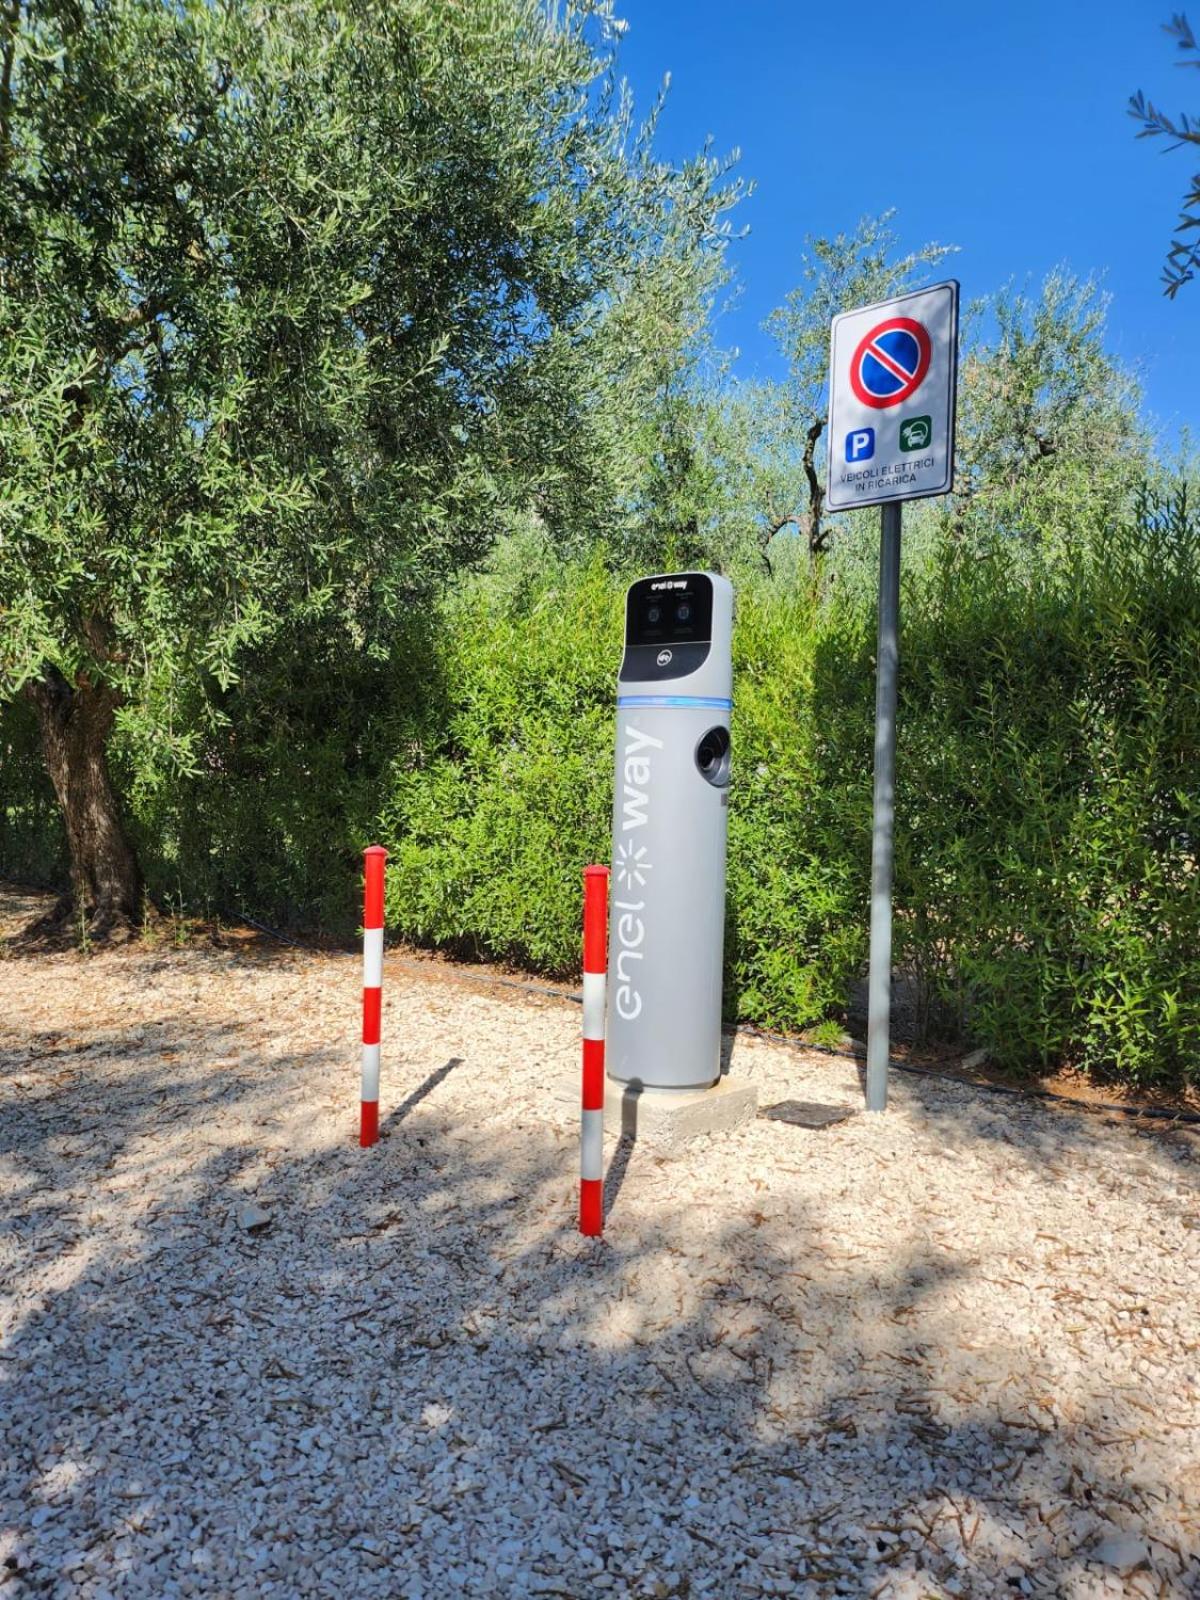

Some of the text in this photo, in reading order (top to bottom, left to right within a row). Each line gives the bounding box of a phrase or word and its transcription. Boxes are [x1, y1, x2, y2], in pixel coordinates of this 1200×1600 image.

[852, 432, 869, 458] P
[840, 457, 934, 482] VEICOLI ELETTRICI
[855, 474, 917, 491] IN RICARICA
[614, 725, 664, 1020] enel way
